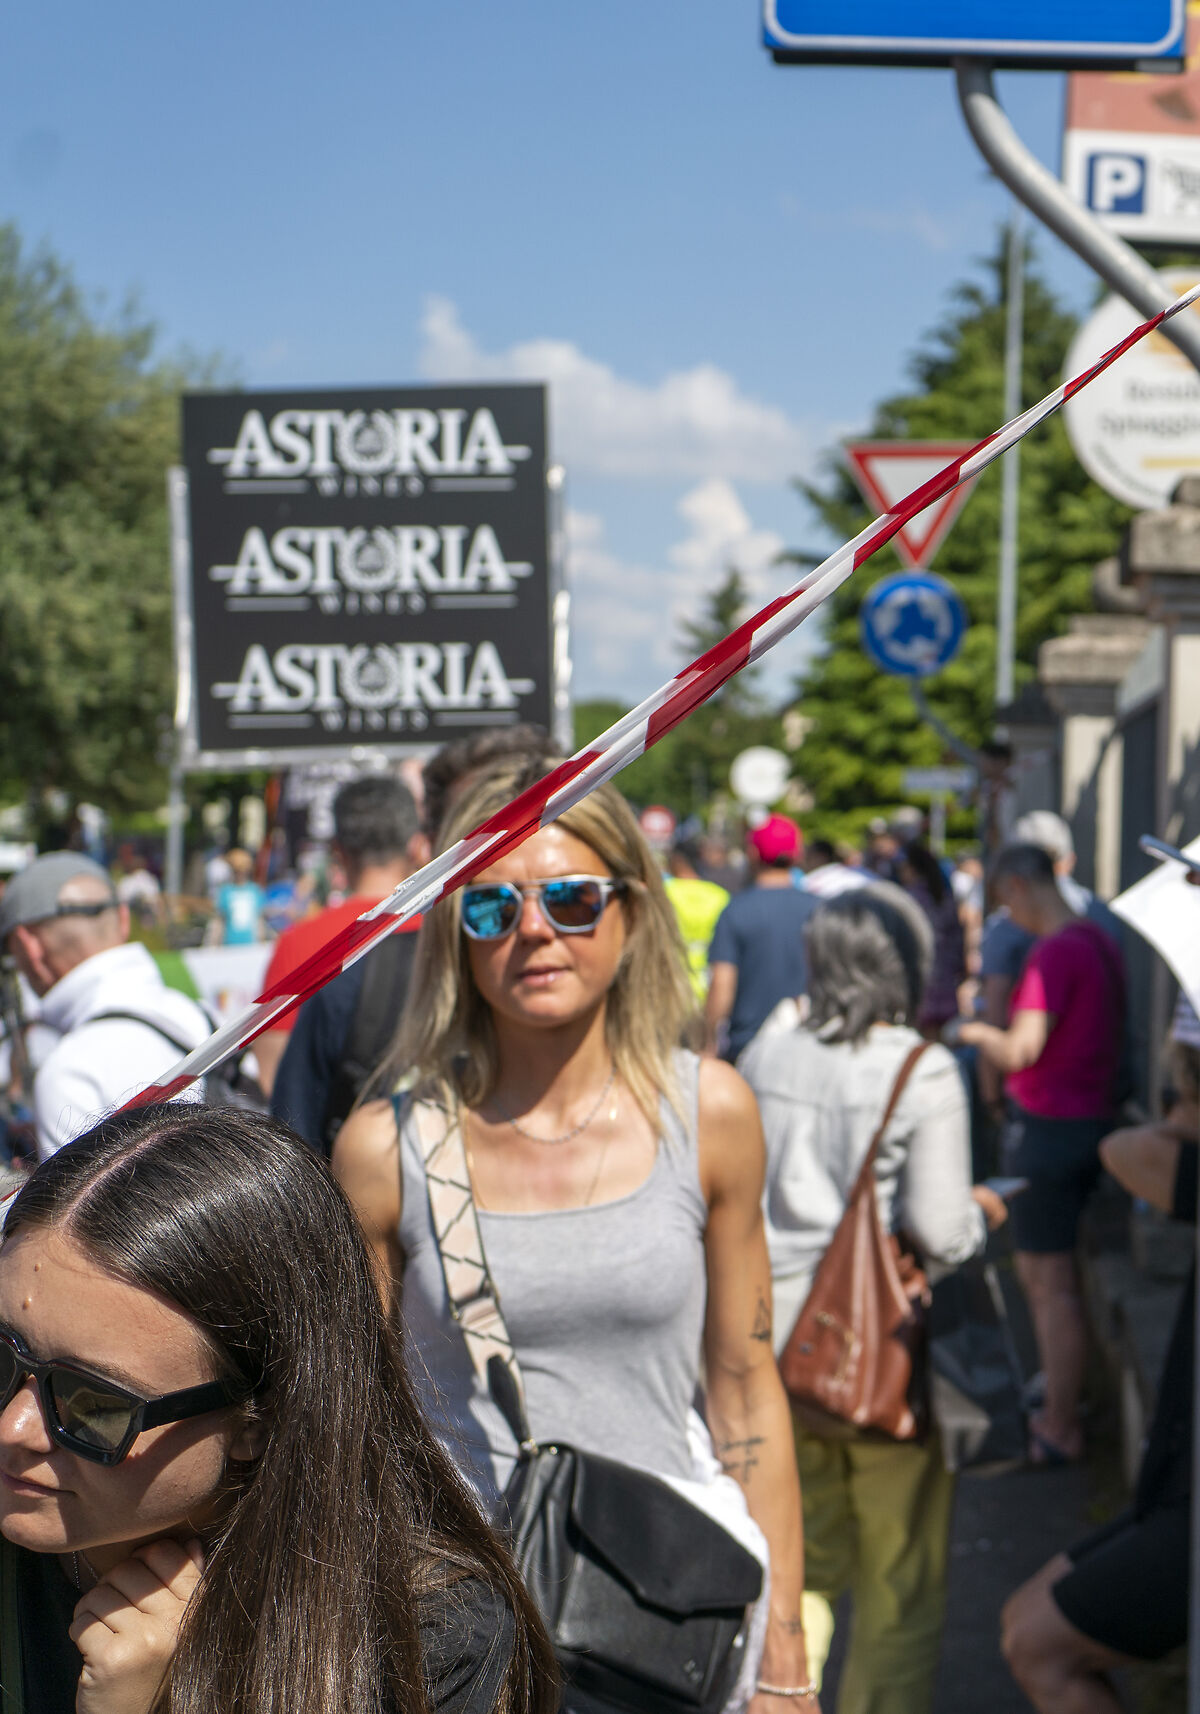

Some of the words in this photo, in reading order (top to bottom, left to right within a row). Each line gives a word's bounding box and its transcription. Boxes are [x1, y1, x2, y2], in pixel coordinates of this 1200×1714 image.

[224, 407, 517, 477] ASTORIA
[316, 475, 424, 497] WINES
[225, 524, 518, 594] ASTORIA
[318, 592, 427, 615] WINES
[227, 641, 519, 712] ASTORIA
[320, 709, 429, 732] WINES
